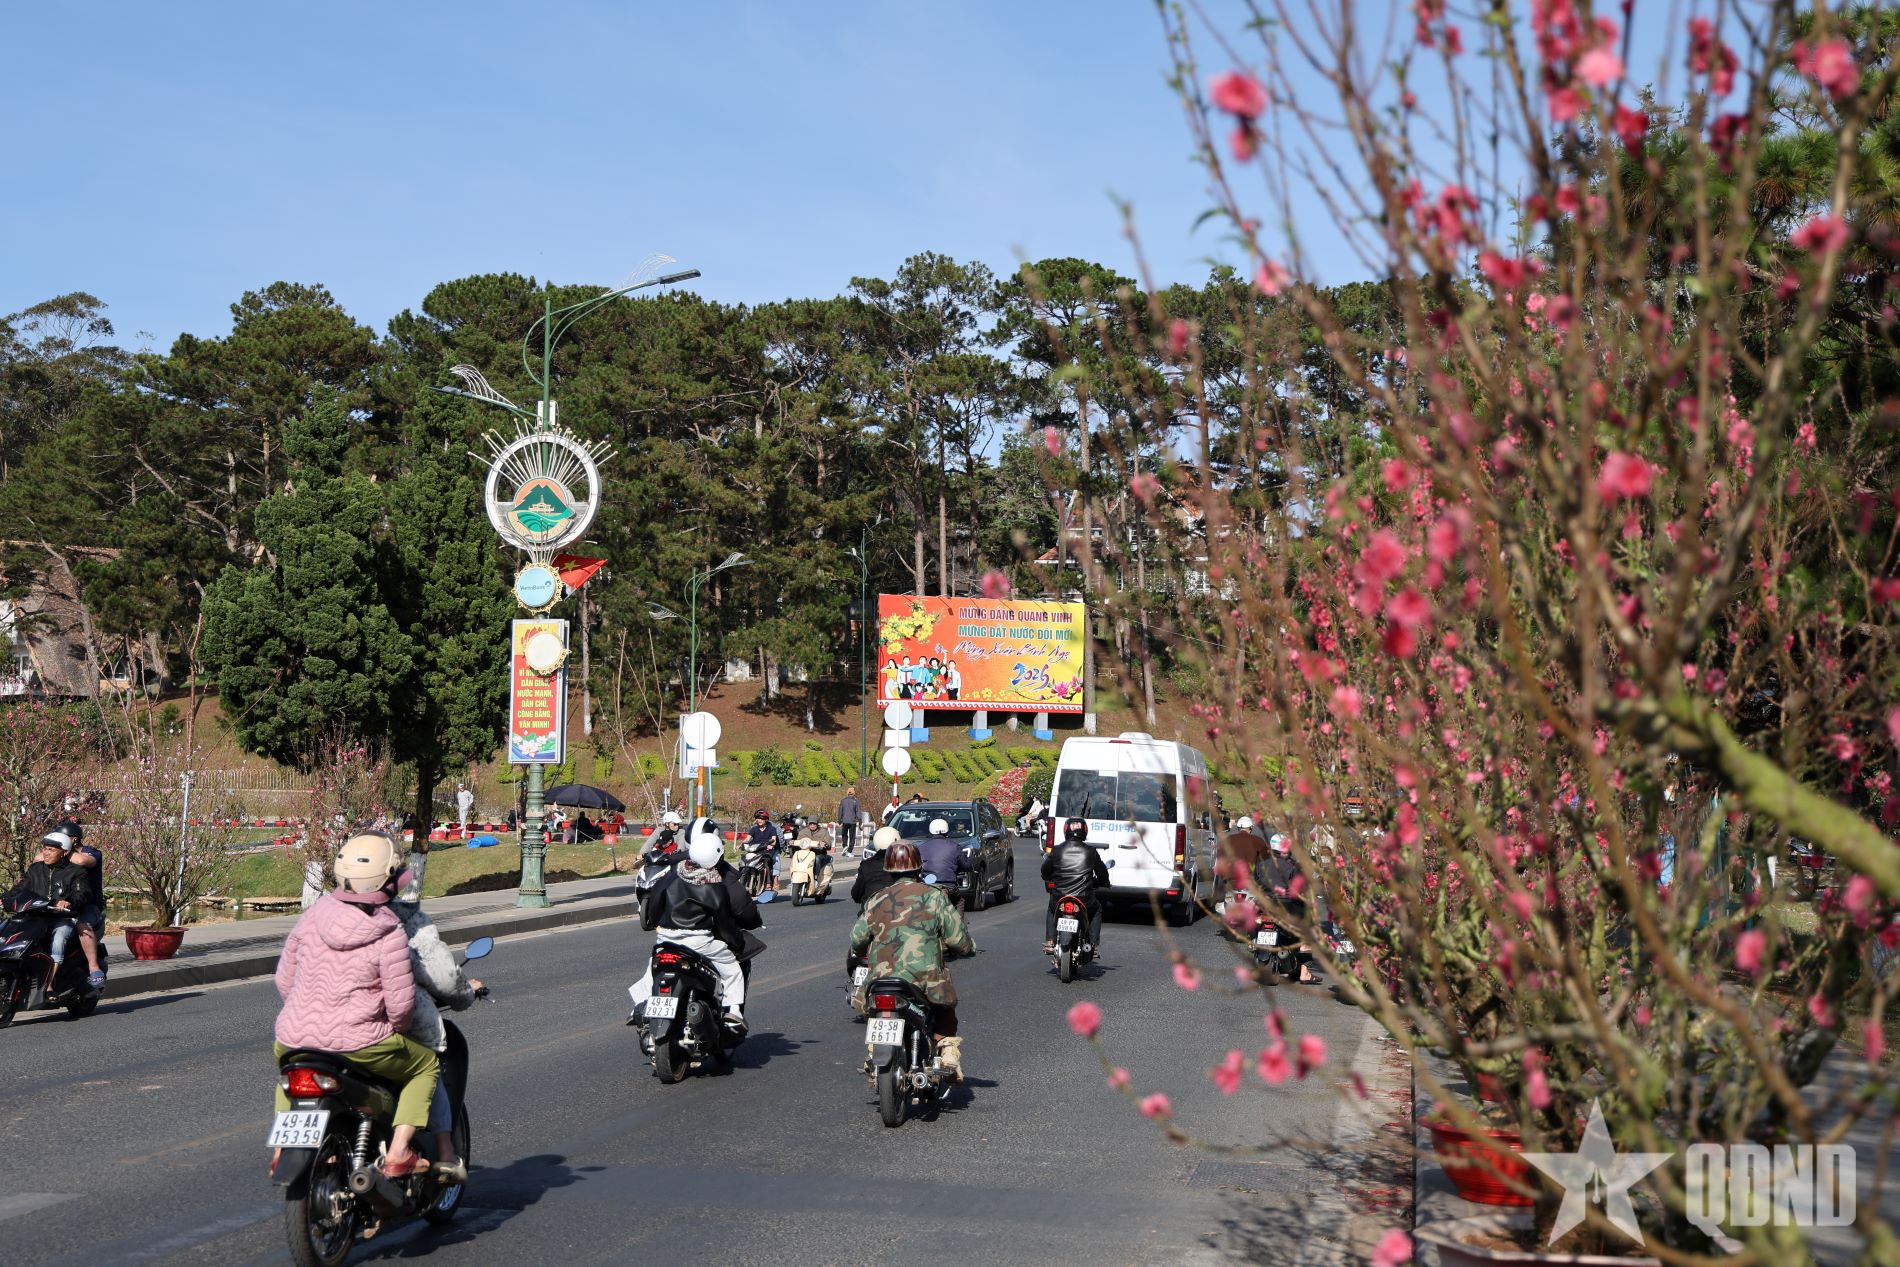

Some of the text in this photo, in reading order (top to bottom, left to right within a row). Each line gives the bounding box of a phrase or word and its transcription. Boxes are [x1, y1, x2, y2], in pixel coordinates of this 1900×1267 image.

[959, 605, 987, 620] MỪNG
[1017, 610, 1048, 622] QUANG
[1050, 611, 1073, 623] VINH
[959, 623, 987, 637] MỪNG
[1009, 625, 1035, 640] NƯỚC
[1011, 662, 1050, 689] 2026
[531, 720, 550, 729] MINH!
[651, 998, 674, 1006] 49-AC
[871, 1031, 897, 1042] 6611
[282, 1114, 319, 1128] 49-AA
[274, 1130, 320, 1144] 153.59
